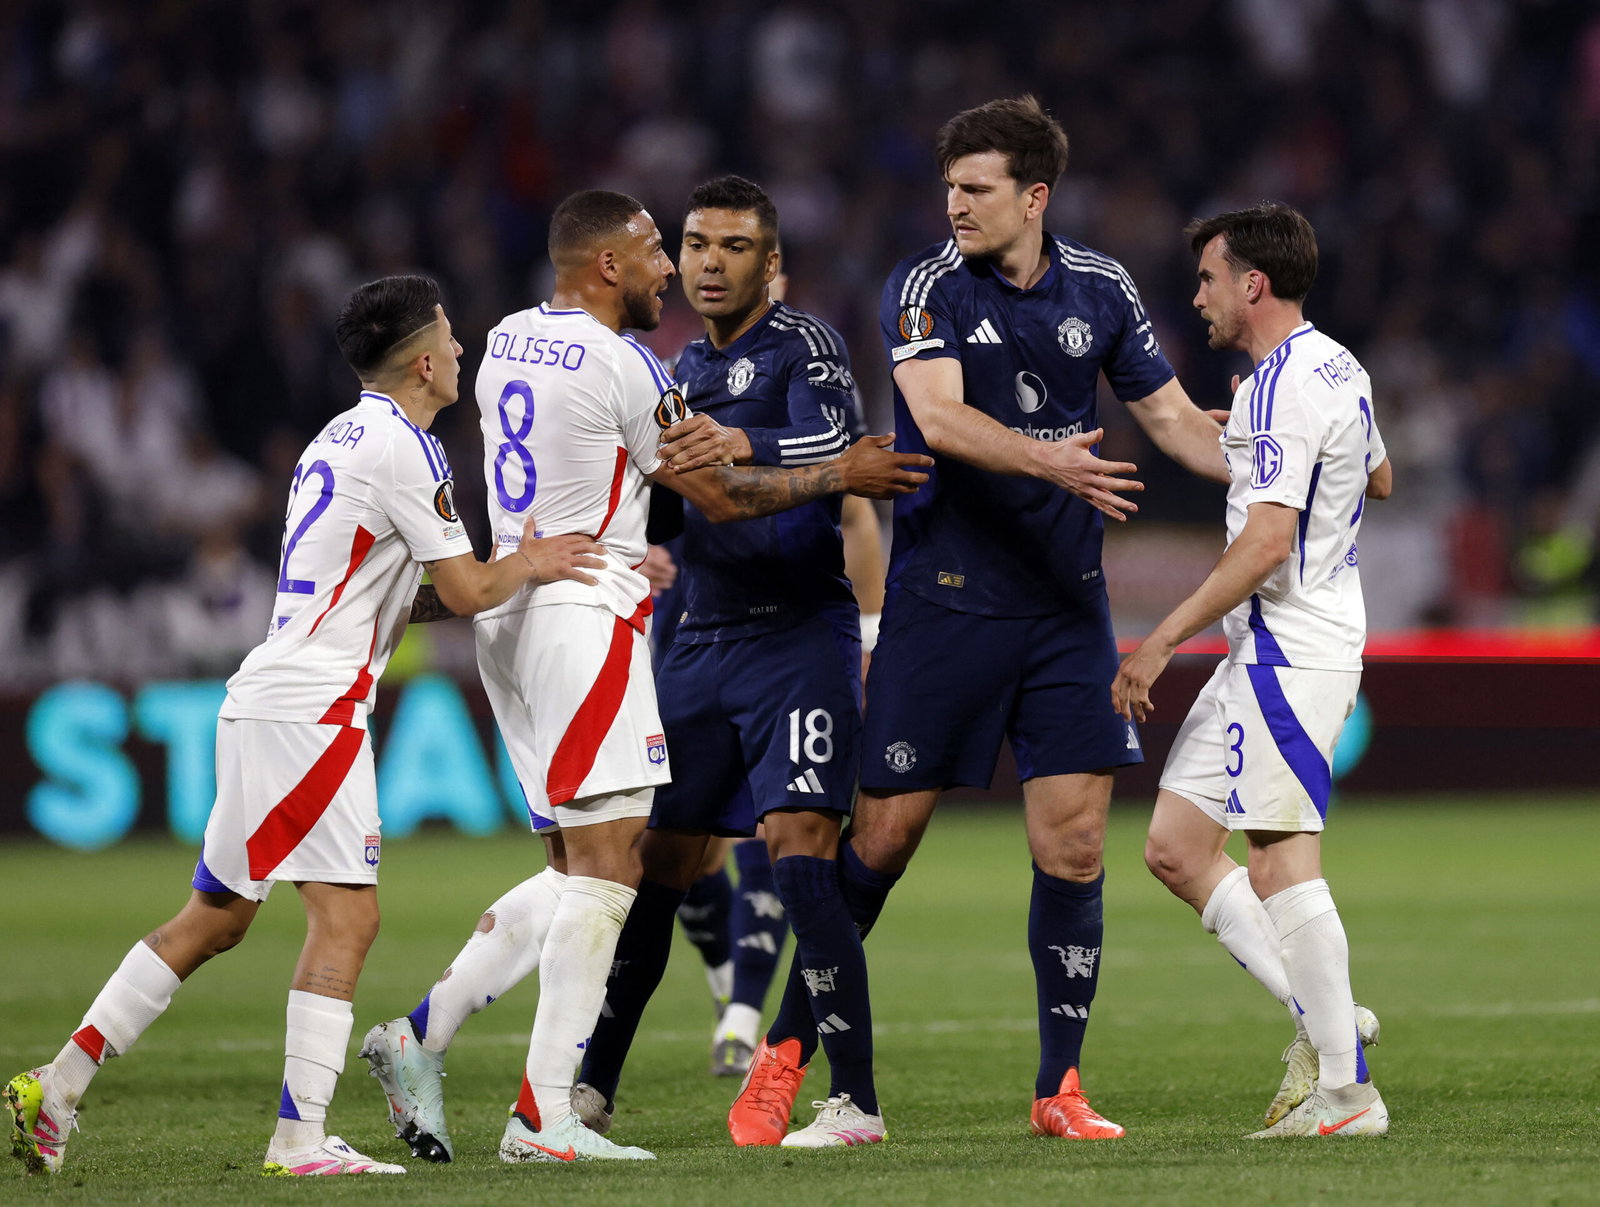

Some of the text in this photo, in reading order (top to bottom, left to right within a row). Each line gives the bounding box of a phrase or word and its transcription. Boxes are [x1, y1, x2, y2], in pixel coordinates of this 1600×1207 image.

[492, 331, 586, 371] OLISSO
[494, 380, 537, 513] 8
[788, 708, 834, 766] 18
[1225, 722, 1245, 778] 3
